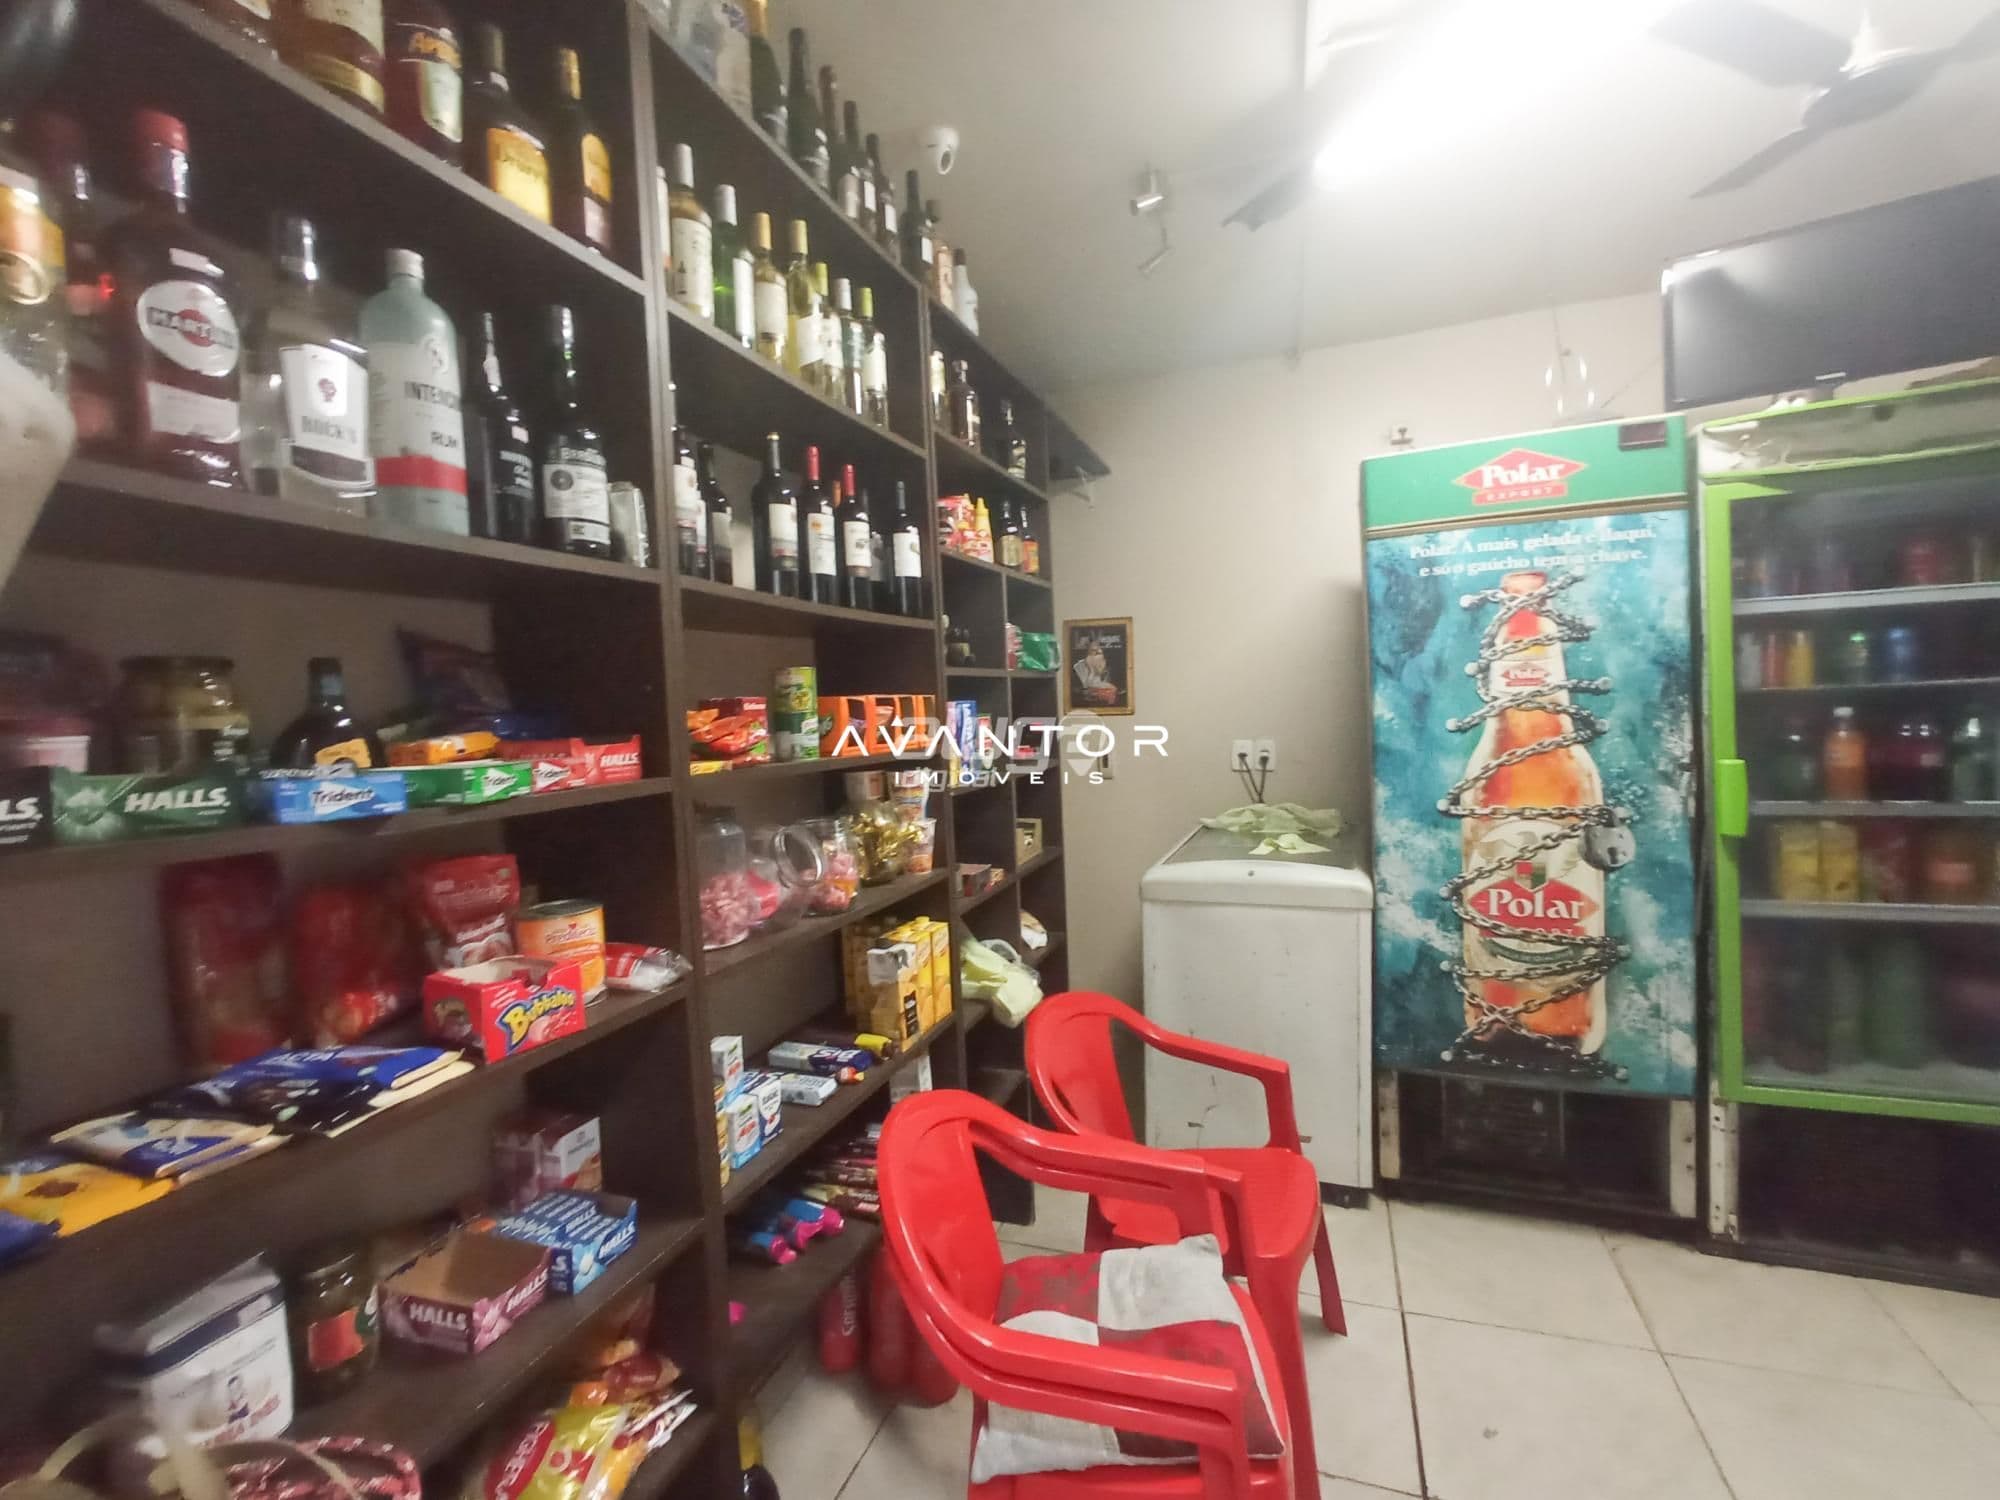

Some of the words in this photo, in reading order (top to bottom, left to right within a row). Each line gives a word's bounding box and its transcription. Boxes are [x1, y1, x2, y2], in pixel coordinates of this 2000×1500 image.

[1481, 460, 1566, 489] Polar
[1486, 485, 1553, 502] EXPORT
[1477, 537, 1519, 553] mais
[312, 787, 377, 804] Trident
[1487, 887, 1585, 920] Polar
[600, 1221, 637, 1261] HALLS
[508, 1268, 549, 1311] HALLS
[408, 1301, 468, 1333] HALLS
